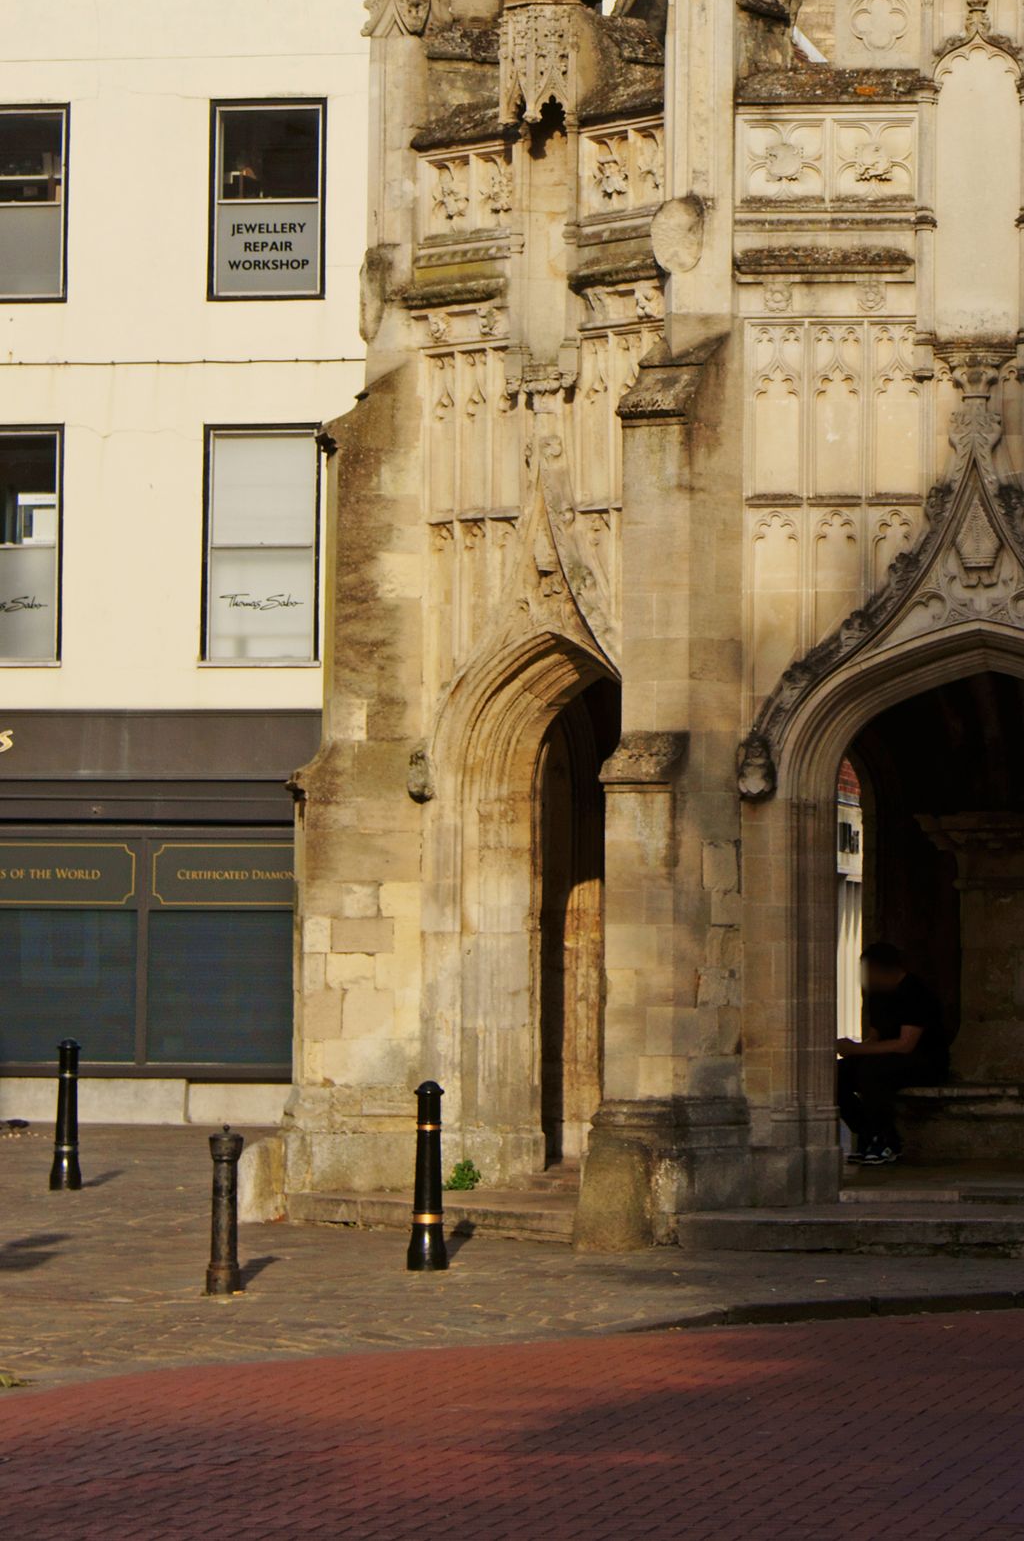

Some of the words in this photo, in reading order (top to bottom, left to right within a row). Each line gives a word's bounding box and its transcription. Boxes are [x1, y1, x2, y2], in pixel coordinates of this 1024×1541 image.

[231, 222, 306, 237] JEWELLERY
[243, 241, 293, 252] REPAIR
[228, 259, 309, 271] WORKSHOP
[219, 593, 262, 609] Thomas
[259, 593, 304, 611] Sabo
[10, 868, 25, 879] OF
[29, 868, 52, 879] THE
[177, 868, 249, 880] CERTIFICATED
